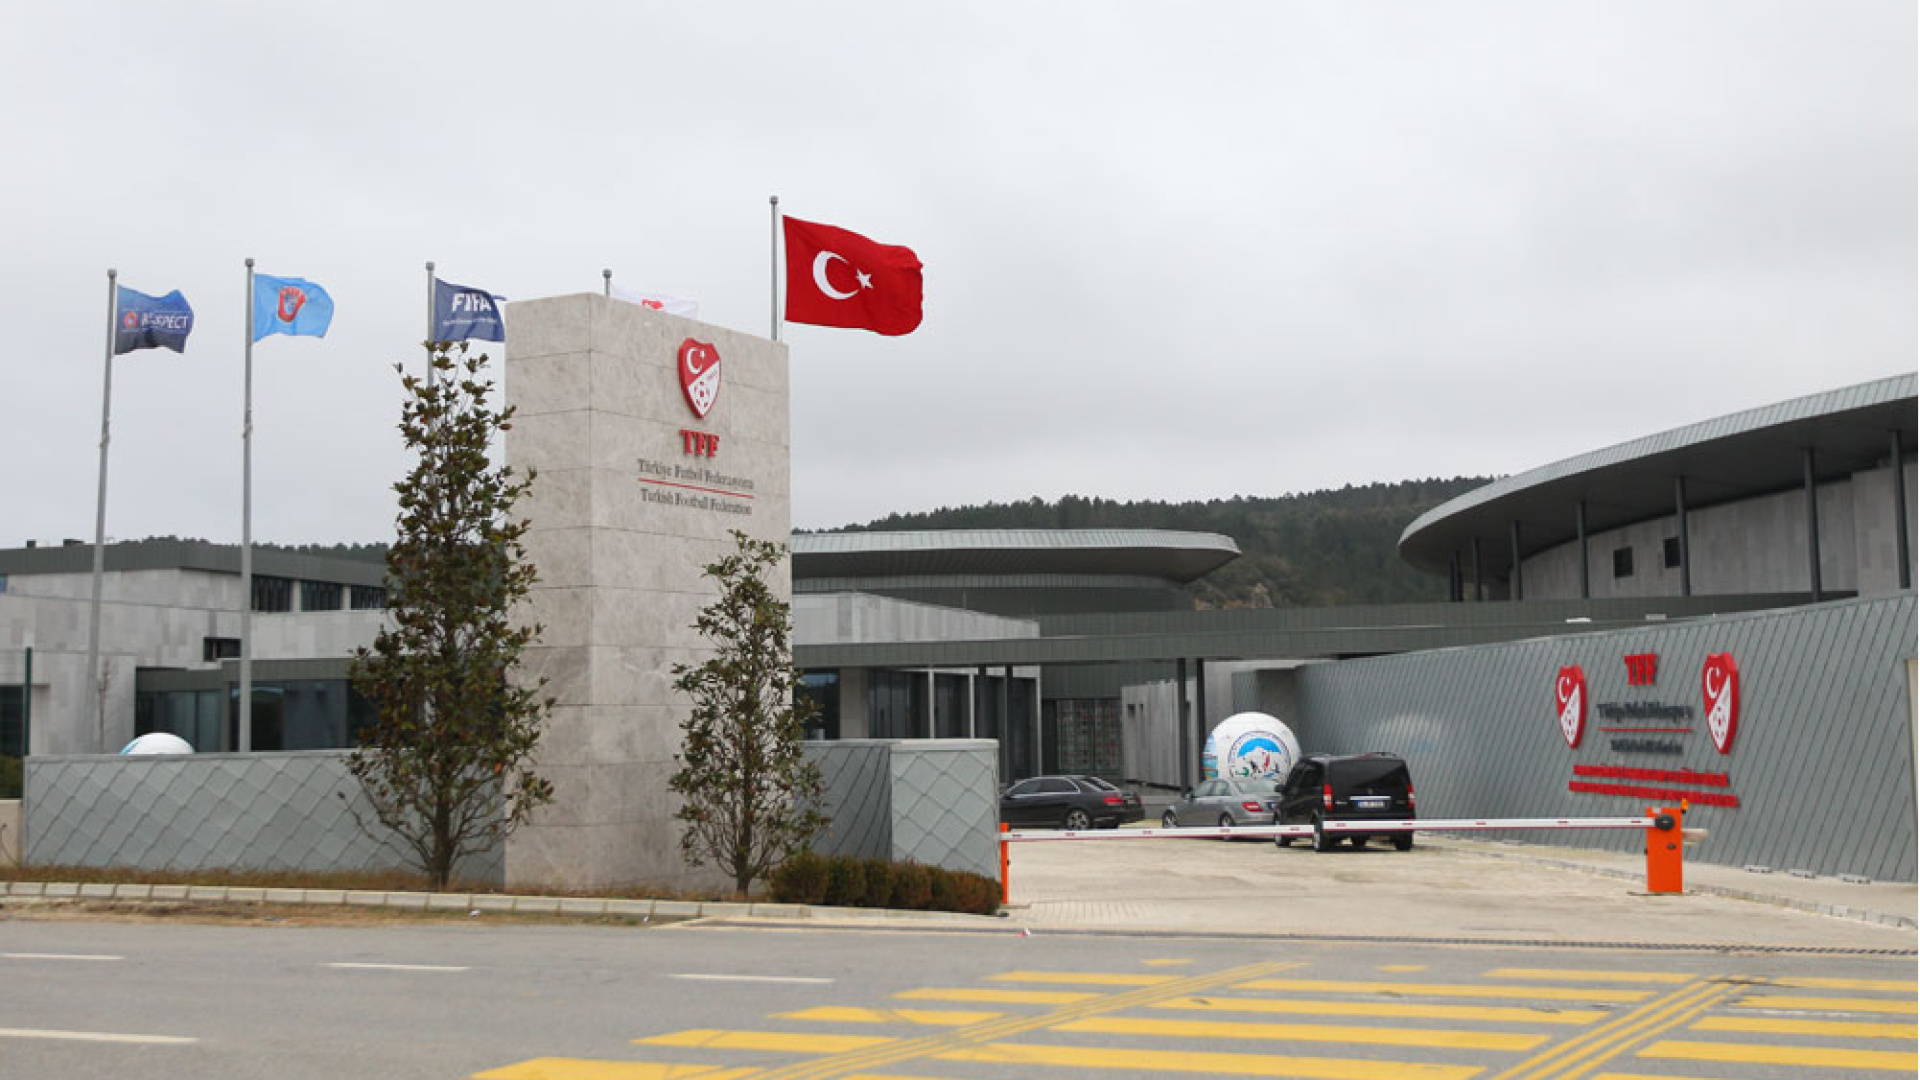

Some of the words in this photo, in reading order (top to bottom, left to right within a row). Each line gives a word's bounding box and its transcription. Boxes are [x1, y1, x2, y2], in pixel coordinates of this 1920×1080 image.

[452, 292, 492, 311] FIFA
[679, 429, 720, 457] TFF
[1623, 653, 1658, 686] TFF
